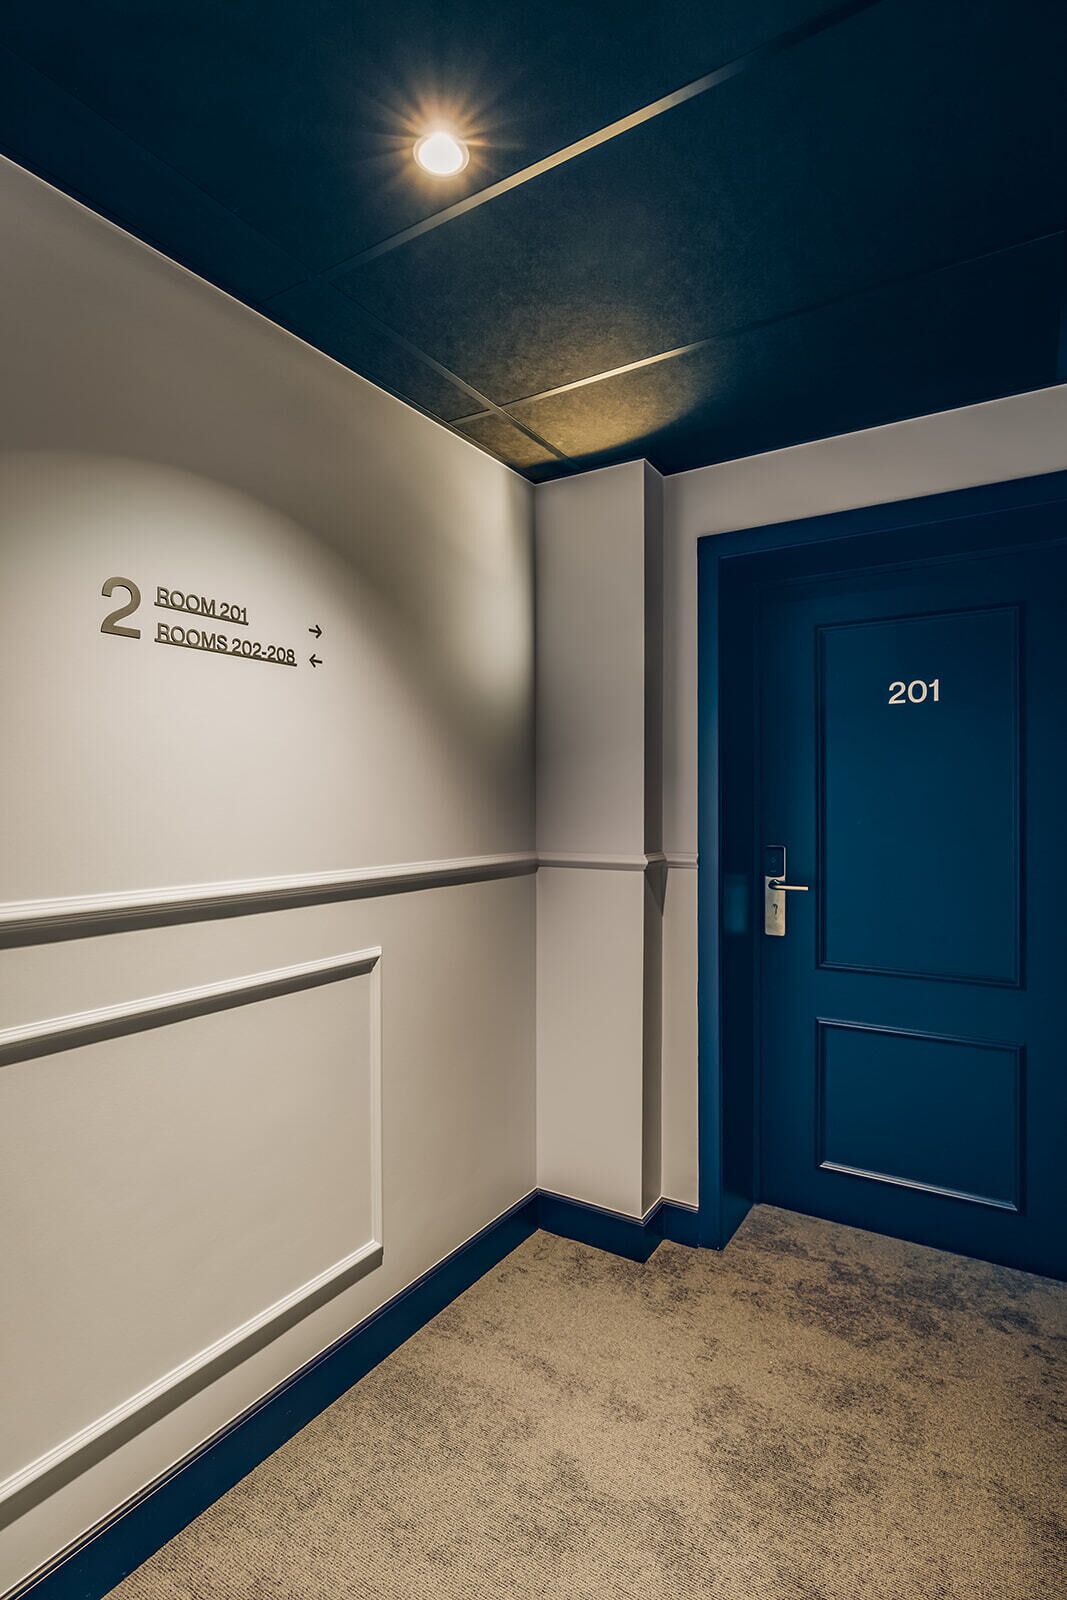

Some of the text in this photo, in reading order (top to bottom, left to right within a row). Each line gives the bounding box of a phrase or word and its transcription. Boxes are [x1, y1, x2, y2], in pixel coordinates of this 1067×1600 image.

[100, 576, 141, 639] 2
[156, 586, 248, 624] ROOM 201
[156, 622, 296, 664] ROOMS 202-208
[888, 678, 940, 705] 201
